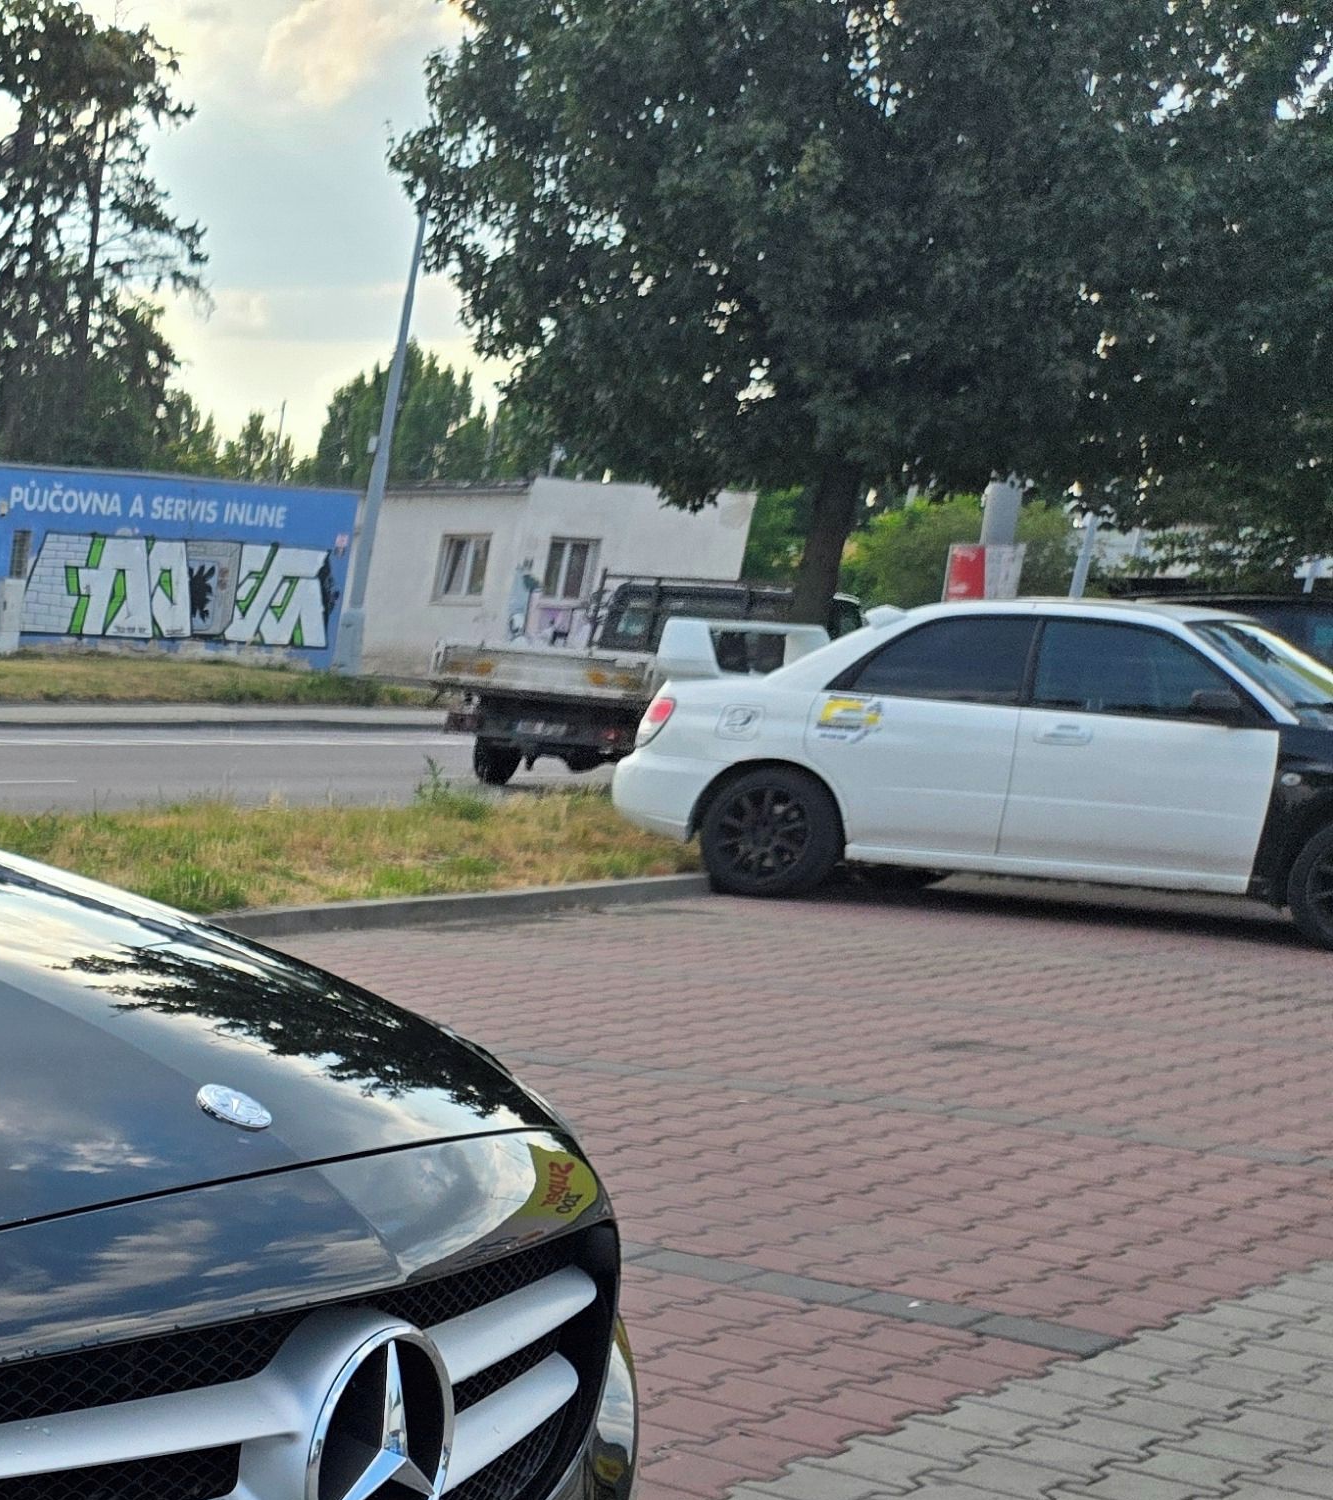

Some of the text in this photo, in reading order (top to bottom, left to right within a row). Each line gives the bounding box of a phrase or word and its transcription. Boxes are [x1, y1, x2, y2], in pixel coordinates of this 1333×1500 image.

[9, 480, 287, 528] PŮJČOVNA A SERVIS INLINE
